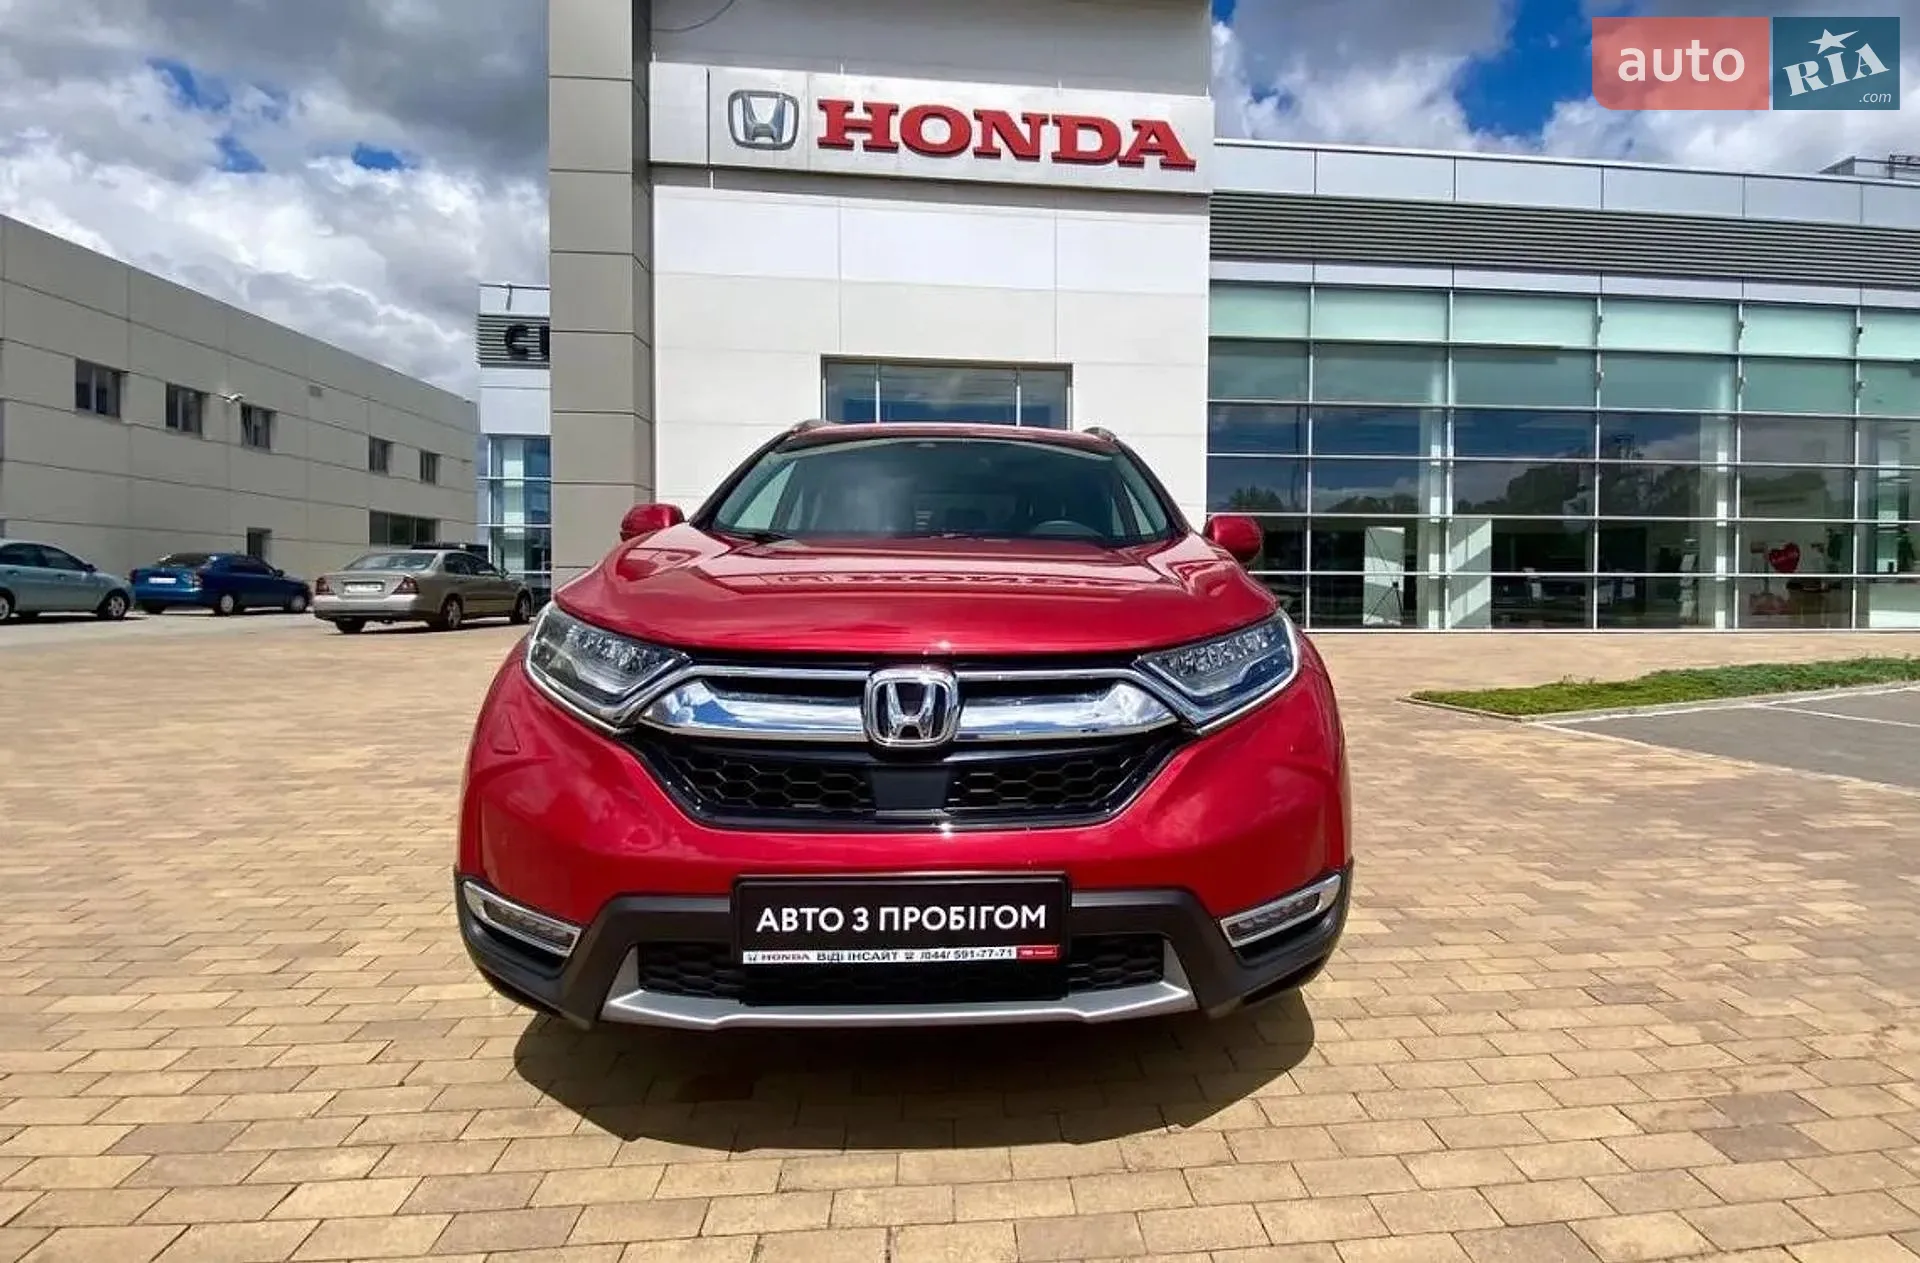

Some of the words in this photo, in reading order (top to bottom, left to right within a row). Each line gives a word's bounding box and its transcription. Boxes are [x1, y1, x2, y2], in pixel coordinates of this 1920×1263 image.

[817, 99, 1196, 172] HONDA
[756, 906, 844, 932] АВТО
[879, 904, 1046, 931] ПРОБІГОМ
[761, 952, 810, 962] HONDA
